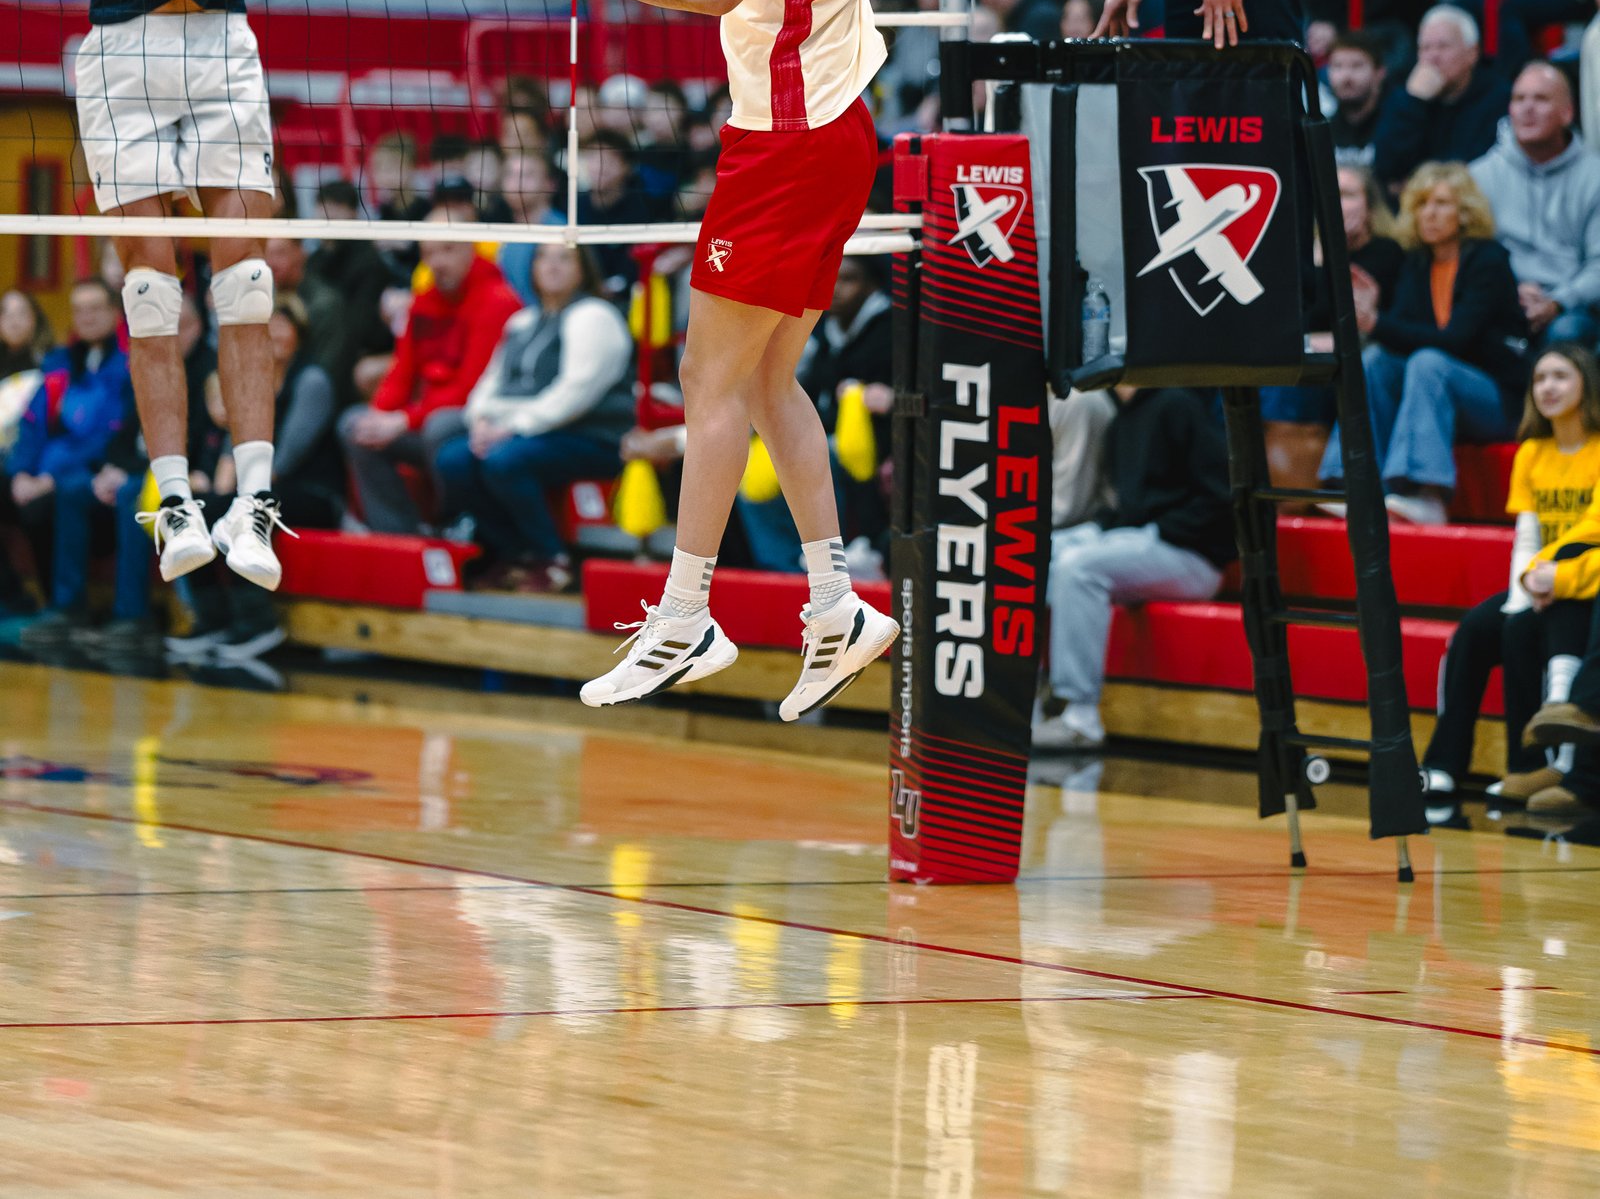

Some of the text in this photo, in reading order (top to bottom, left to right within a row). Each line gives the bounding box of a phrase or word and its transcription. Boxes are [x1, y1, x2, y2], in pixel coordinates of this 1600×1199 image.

[956, 164, 1024, 184] LEWIS
[1151, 116, 1263, 143] LEWIS
[710, 237, 733, 248] LEWIS
[934, 361, 991, 699] FLYERS
[993, 405, 1041, 657] LEWIS
[900, 578, 913, 758] sports imports
